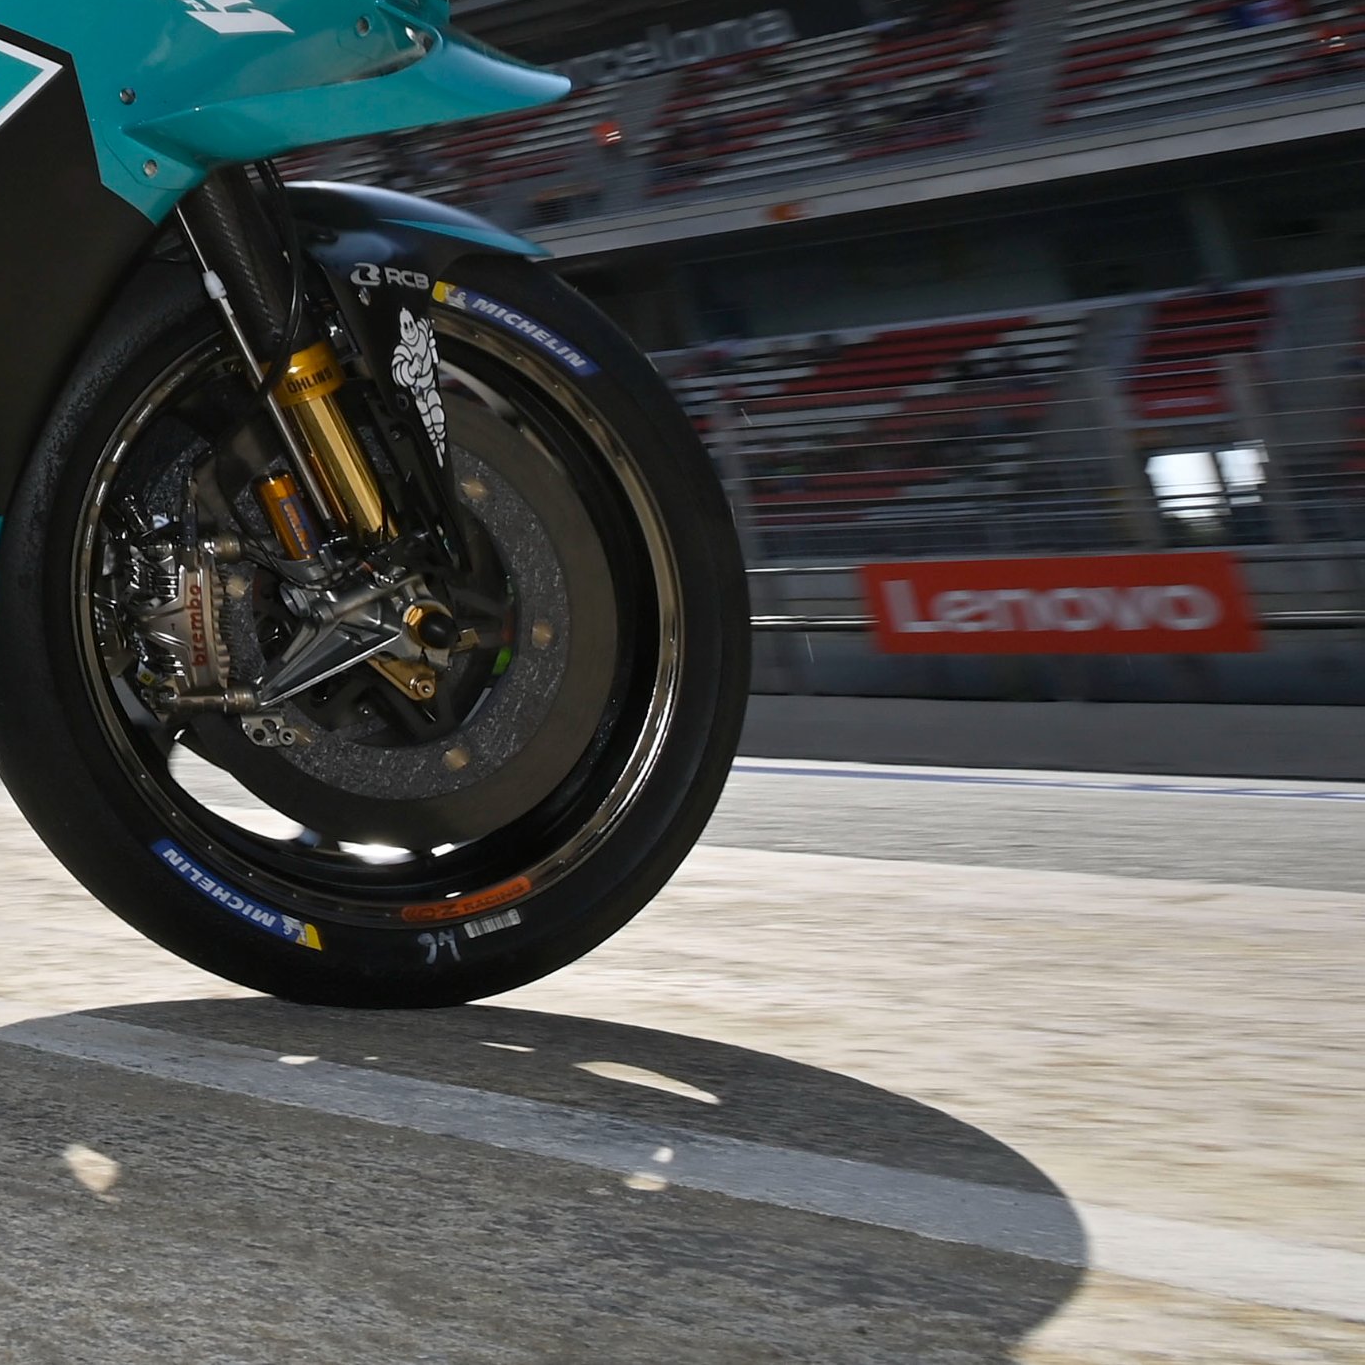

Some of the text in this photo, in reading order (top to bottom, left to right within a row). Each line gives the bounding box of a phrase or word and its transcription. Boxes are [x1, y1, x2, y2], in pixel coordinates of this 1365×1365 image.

[384, 267, 430, 290] RCB
[472, 297, 588, 368] MICHELIN
[186, 584, 207, 667] brembo
[881, 578, 1223, 633] Lenovo
[162, 848, 277, 927] MICHELIN
